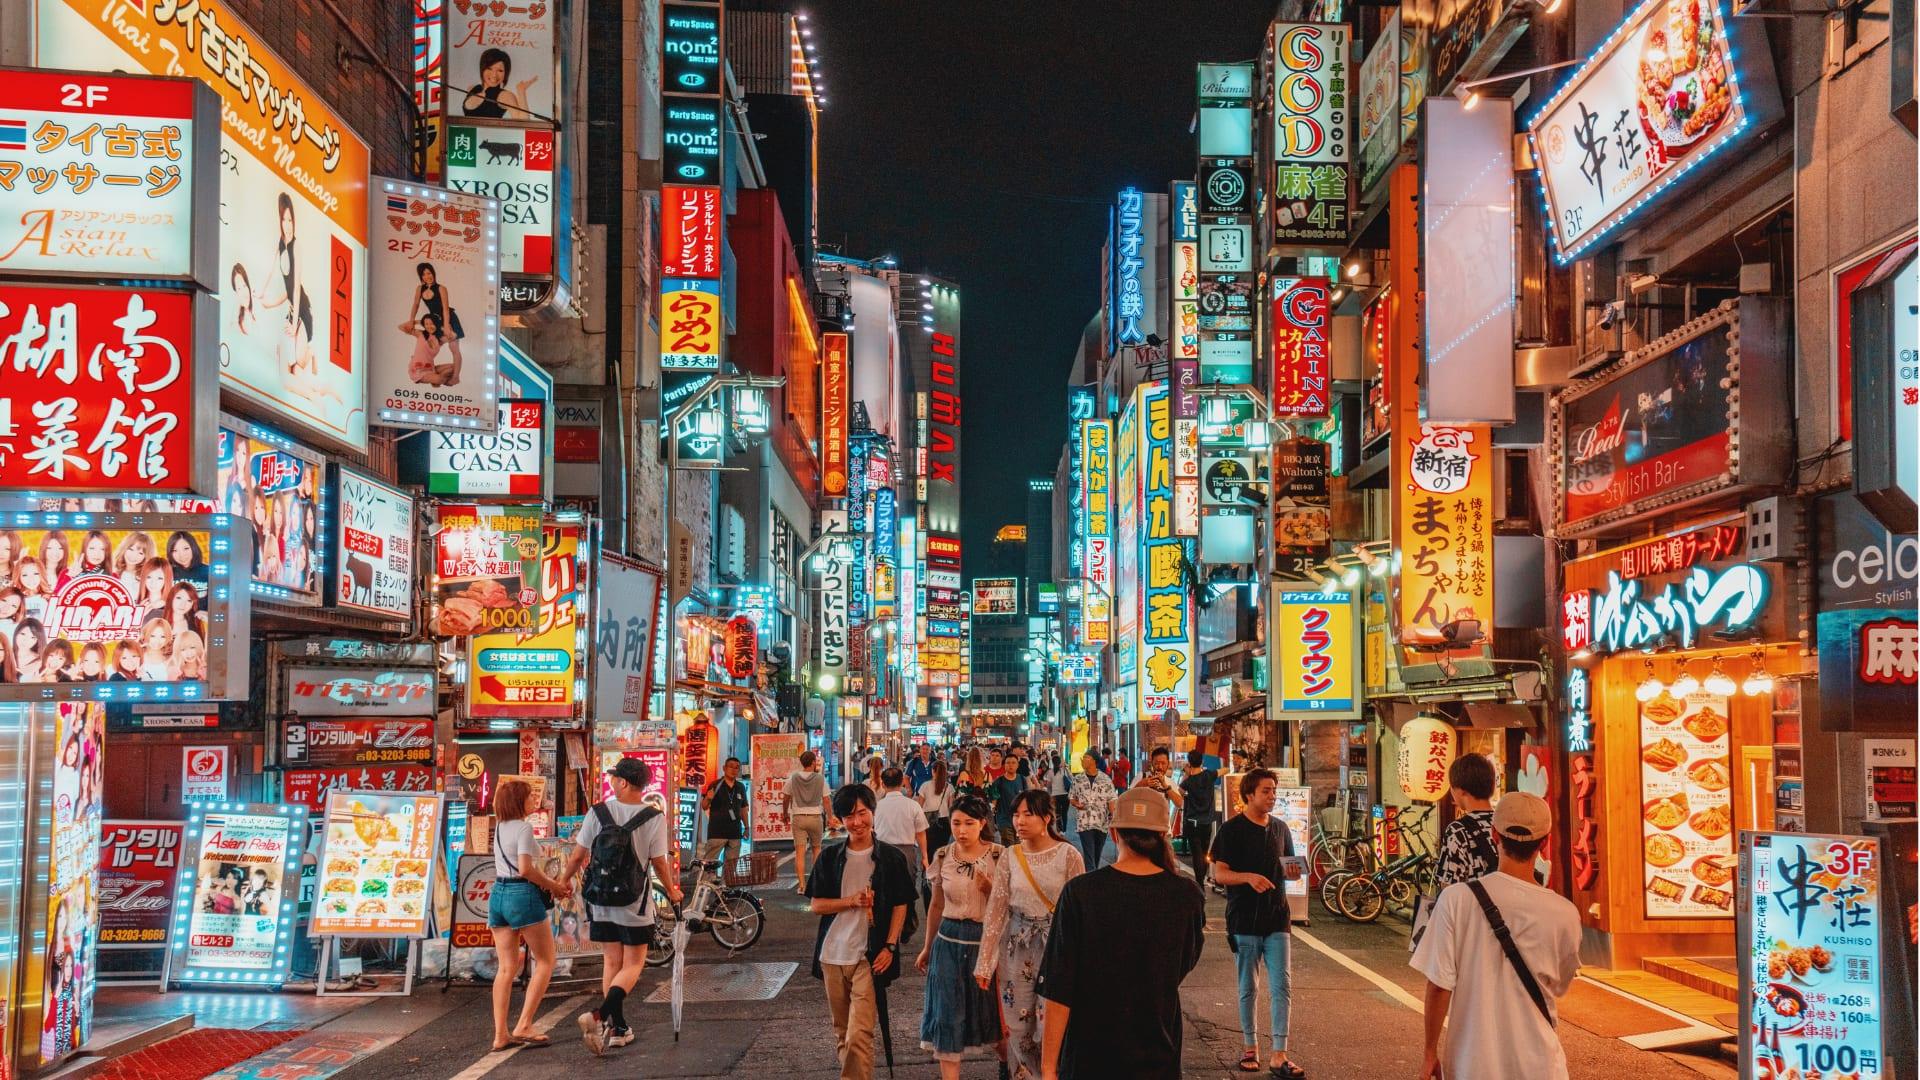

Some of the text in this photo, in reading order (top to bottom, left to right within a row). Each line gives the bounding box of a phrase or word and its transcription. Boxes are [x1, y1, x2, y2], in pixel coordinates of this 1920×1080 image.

[669, 19, 715, 30] Party Space
[685, 75, 698, 84] 4F
[60, 83, 109, 108] 2F
[1279, 25, 1326, 159] GOD
[669, 110, 715, 121] Party Space
[33, 119, 182, 160] タイ古式
[455, 133, 471, 150] 肉
[450, 150, 475, 160] バル
[0, 159, 182, 198] マッサージ
[271, 135, 339, 212] Massage
[685, 167, 698, 176] 3F
[1276, 164, 1348, 201] 麻雀
[59, 208, 176, 225] アジアンリラックス
[408, 199, 481, 228] タイ古式
[502, 203, 541, 225] SA
[1217, 217, 1236, 225] 5F
[1306, 203, 1346, 229] 4F
[1564, 206, 1584, 238] 3F
[387, 214, 481, 244] マッサージ
[681, 190, 699, 275] リフレッシュ
[387, 239, 414, 253] 2F
[665, 265, 676, 274] 2F
[1120, 186, 1144, 344] カラオケの鉄人
[1276, 279, 1291, 290] 3F
[669, 294, 713, 354] らーめん
[1282, 286, 1326, 408] CARINA
[663, 355, 718, 367] 博多天神
[1288, 329, 1304, 406] カリーナ
[394, 388, 420, 399] 60分
[663, 386, 687, 403] Party
[385, 398, 480, 418] 03-3207-5527
[829, 350, 841, 464] 個室ダイニング居酒屋
[438, 431, 532, 452] XROSS
[1573, 408, 1630, 465] Real
[260, 453, 300, 488] 即デート
[449, 452, 524, 473] CASA
[1281, 466, 1324, 477] Walton's
[1414, 446, 1468, 479] 新宿
[343, 479, 387, 506] ヘルシー
[1433, 476, 1450, 491] の
[878, 491, 893, 545] カラオケ
[1453, 499, 1469, 595] 九州のうまかもん
[1620, 526, 1739, 580] 旭川味噌ラーメン
[1411, 496, 1453, 629] まっちゃん
[63, 579, 111, 605] community
[1875, 588, 1912, 605] Stylish
[1302, 608, 1334, 696] クラウン
[1144, 696, 1188, 709] マンボー
[1310, 701, 1326, 709] B1
[183, 719, 205, 727] CASA
[310, 730, 373, 746] レンタルルーム
[373, 723, 433, 749] Eden
[365, 749, 431, 762] 03-3203-9666
[1423, 731, 1450, 794] 鉄なべ餃子
[248, 838, 282, 852] Relax
[112, 846, 175, 868] ルーム
[204, 852, 239, 862] Welcome
[1827, 843, 1871, 876] 3F
[101, 928, 166, 942] 03-3203-9666
[1823, 935, 1873, 946] KUSHISO
[1804, 1024, 1849, 1040] 串揚げ
